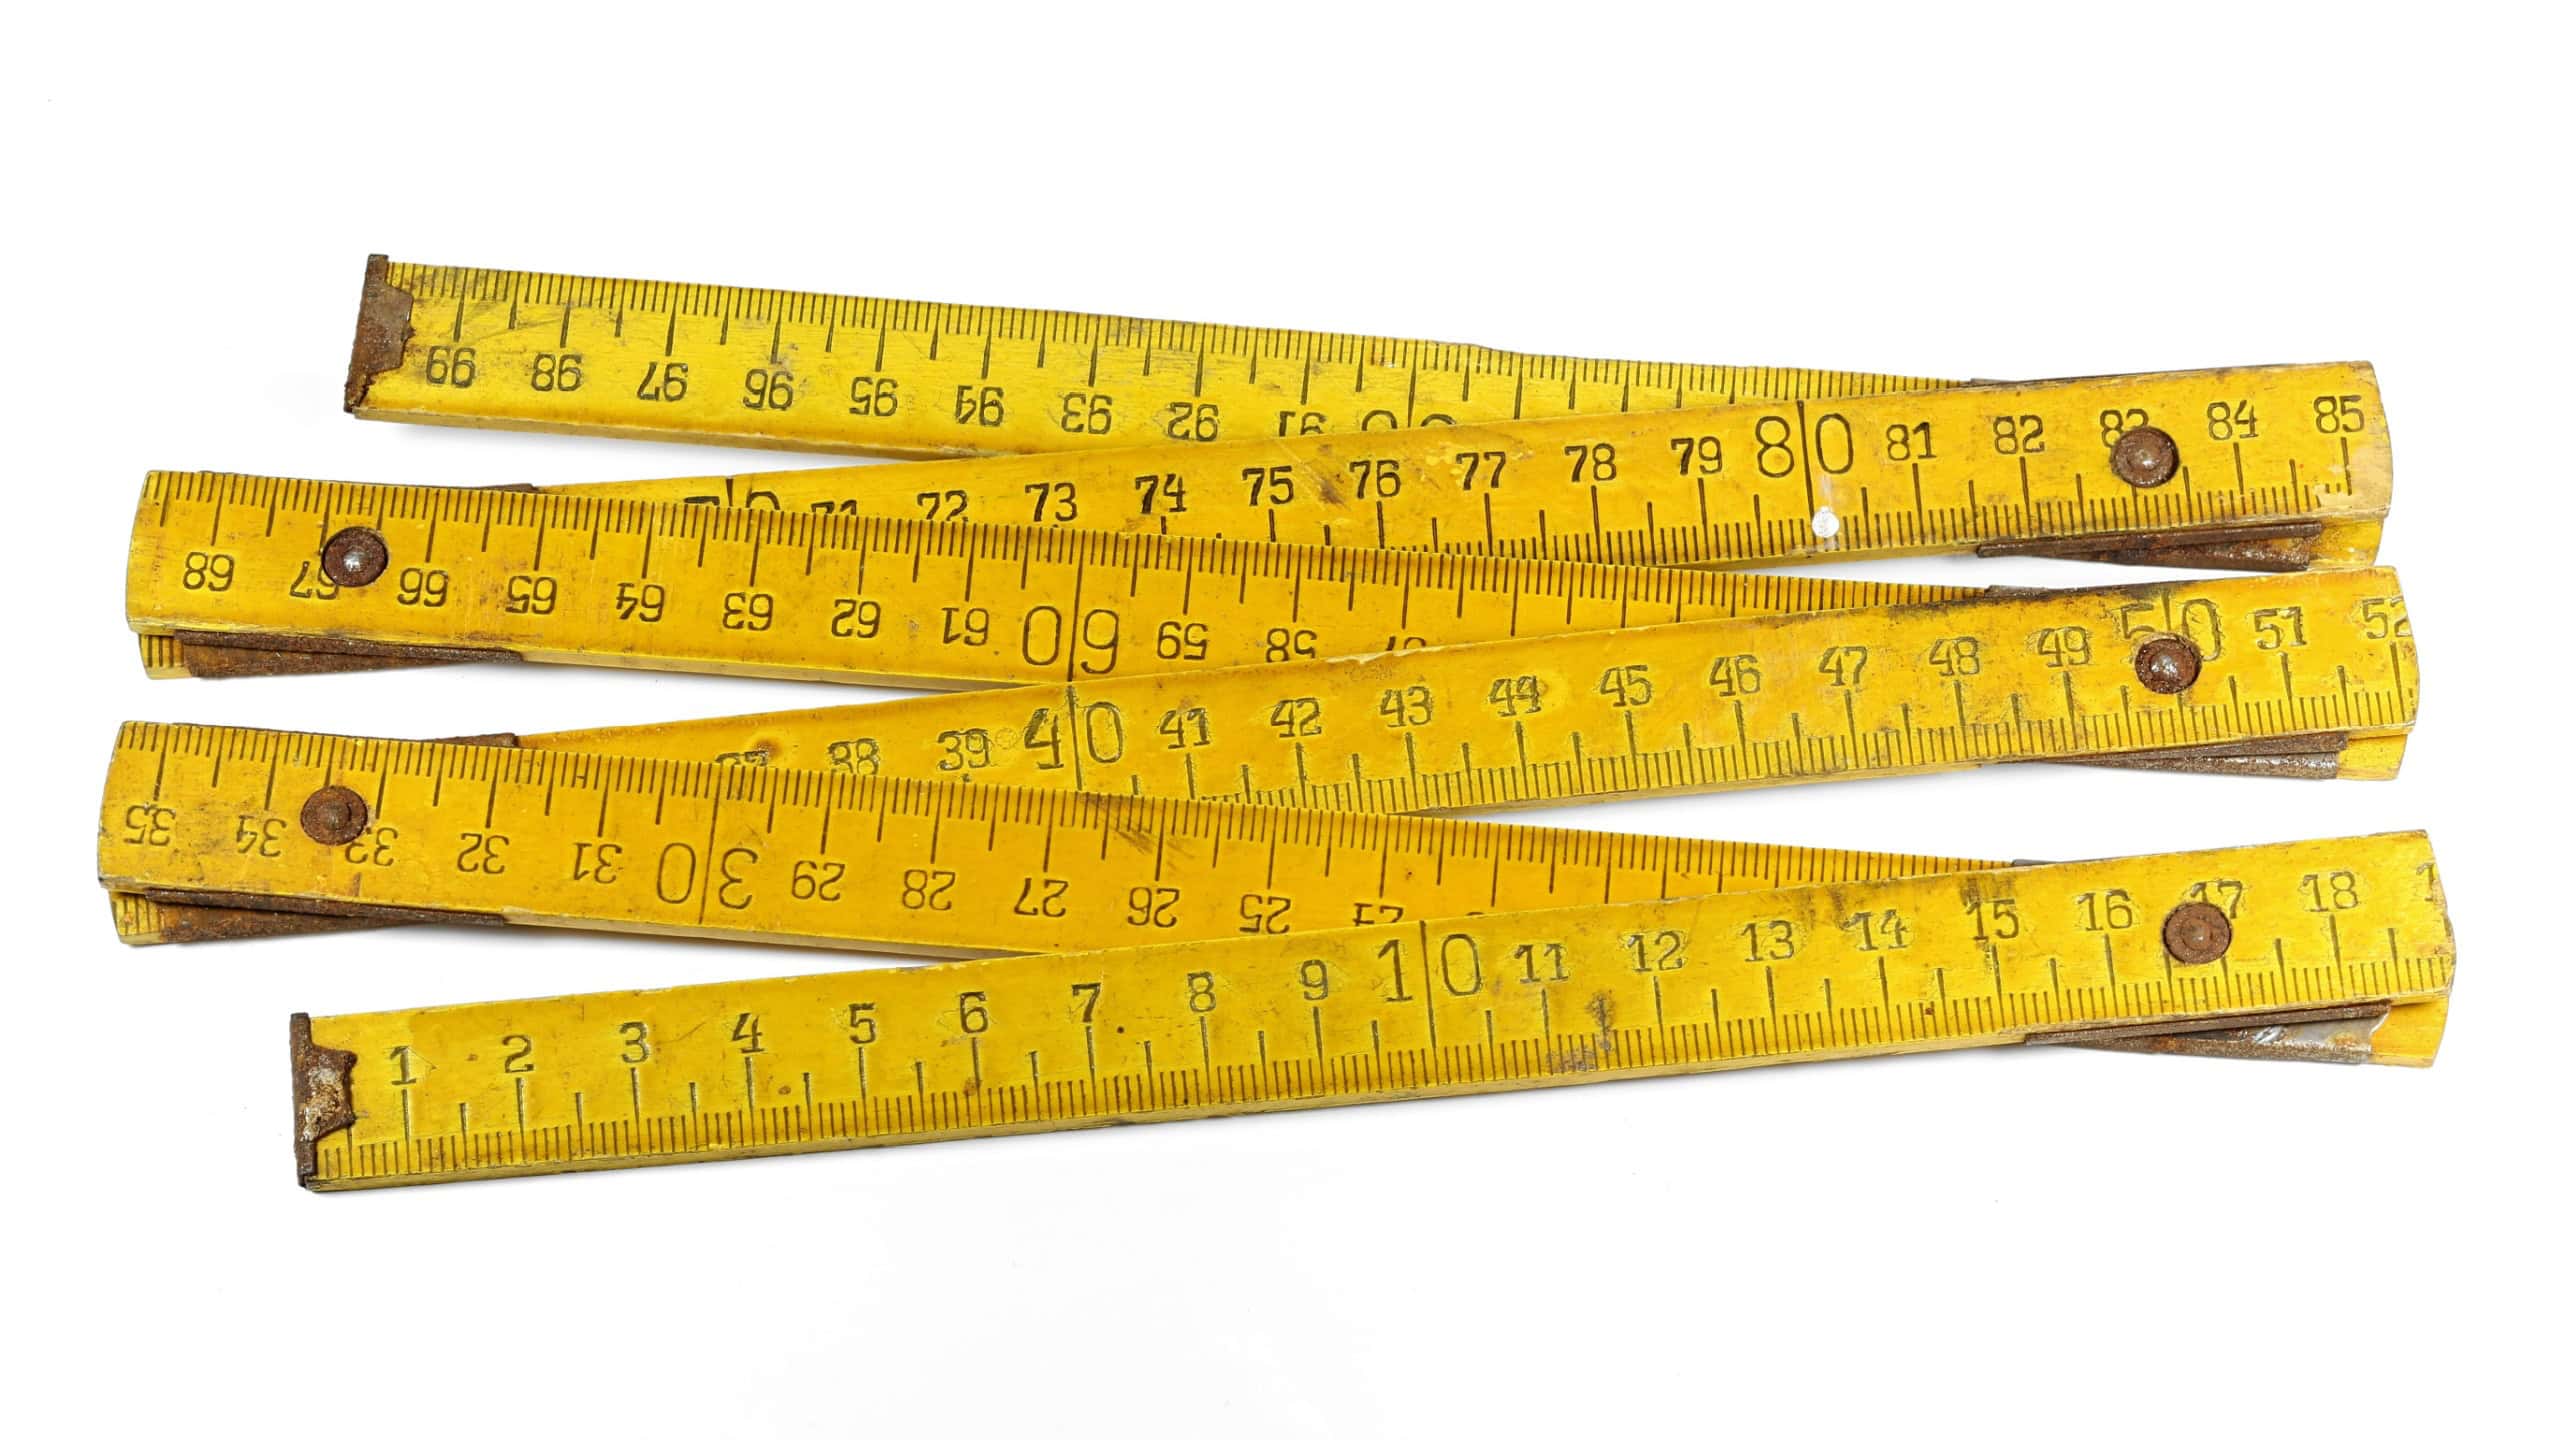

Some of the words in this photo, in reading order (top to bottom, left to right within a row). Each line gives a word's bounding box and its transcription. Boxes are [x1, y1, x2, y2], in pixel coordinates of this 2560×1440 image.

[426, 346, 476, 388] 99
[531, 353, 582, 392] 98
[637, 362, 689, 402] 97
[742, 372, 795, 411] 96
[849, 376, 899, 417] 95
[955, 385, 1004, 427] 94
[1061, 392, 1113, 434] 93
[1167, 402, 1219, 442] 92
[917, 489, 968, 522] 72
[1025, 483, 1079, 522] 73
[1135, 474, 1186, 514] 74
[1242, 466, 1294, 506] 75
[1349, 460, 1401, 499] 76
[1455, 452, 1506, 490] 77
[1564, 443, 1617, 482] 78
[1671, 437, 1724, 475] 79
[1755, 413, 1853, 478] 80
[1886, 423, 1937, 461] 81
[1993, 415, 2045, 455] 82
[2207, 400, 2259, 440] 84
[2313, 395, 2365, 434] 85
[183, 552, 234, 592] 68
[399, 568, 449, 607] 66
[506, 575, 557, 615] 65
[616, 583, 665, 623] 64
[723, 592, 774, 632] 63
[831, 599, 881, 639] 62
[942, 607, 990, 647] 61
[1022, 605, 1120, 675] 60
[1157, 621, 1209, 660] 59
[1265, 628, 1318, 663] 58
[827, 737, 880, 776] 38
[937, 728, 991, 771] 39
[1023, 701, 1123, 769] 40
[1158, 708, 1211, 749] 41
[1270, 698, 1323, 738] 42
[1379, 686, 1433, 728] 43
[1489, 676, 1541, 717] 44
[1599, 665, 1652, 708] 45
[1709, 654, 1762, 697] 46
[1819, 646, 1867, 687] 47
[1929, 636, 1980, 676] 48
[2037, 626, 2091, 668] 49
[2253, 605, 2307, 651] 51
[2361, 595, 2413, 639] 52
[125, 804, 177, 846] 35
[236, 815, 287, 858] 34
[344, 826, 399, 867] 33
[457, 832, 510, 874] 32
[573, 843, 623, 883] 31
[656, 842, 758, 910] 30
[791, 860, 846, 901] 29
[901, 869, 956, 911] 28
[1013, 877, 1069, 918] 27
[1127, 887, 1180, 928] 26
[1240, 893, 1291, 934] 25
[391, 1045, 417, 1086] 1
[502, 1035, 534, 1074] 2
[620, 1021, 650, 1064] 3
[732, 1013, 766, 1054] 4
[849, 1003, 876, 1045] 5
[959, 991, 988, 1034] 6
[1072, 983, 1102, 1024] 7
[1187, 971, 1216, 1013] 8
[1300, 959, 1329, 1000] 9
[1378, 933, 1482, 1002] 10
[1513, 943, 1568, 984] 11
[1627, 930, 1684, 973] 12
[1741, 919, 1795, 963] 13
[1845, 908, 1908, 950] 14
[1966, 899, 2020, 943] 15
[2077, 889, 2134, 932] 16
[2303, 872, 2358, 913] 18
